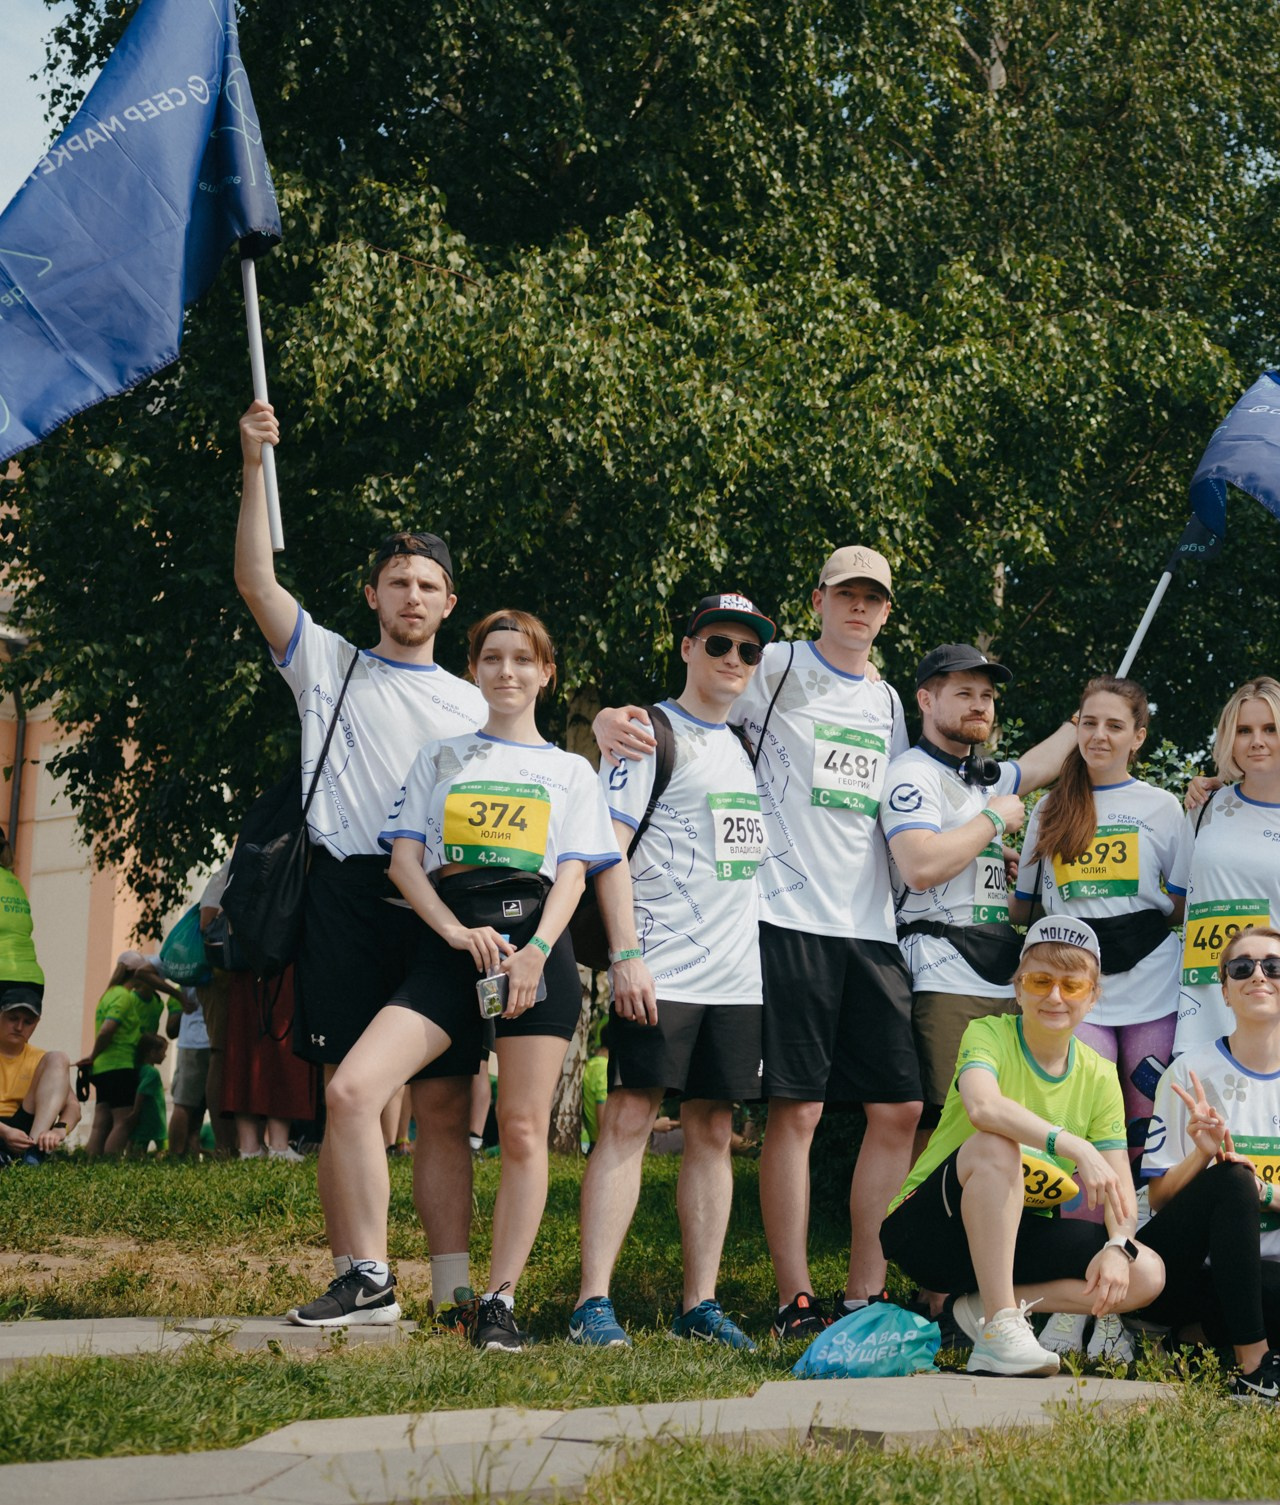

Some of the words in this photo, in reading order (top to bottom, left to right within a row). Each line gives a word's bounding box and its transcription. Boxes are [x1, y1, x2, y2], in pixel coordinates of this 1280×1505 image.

[719, 594, 752, 607] RUN
[343, 724, 355, 749] 360
[530, 773, 553, 782] СБЕР
[823, 750, 878, 783] 4681
[819, 790, 831, 804] C
[329, 789, 350, 830] products
[468, 801, 528, 831] 374
[480, 829, 511, 840] ЮЛИЯ
[680, 817, 697, 840] 360
[723, 817, 764, 843] 2595
[452, 846, 464, 862] D
[662, 861, 685, 890] Digital
[680, 887, 704, 925] products
[1040, 927, 1089, 947] MOLTENI
[1193, 923, 1254, 951] 469
[675, 955, 707, 975] Content
